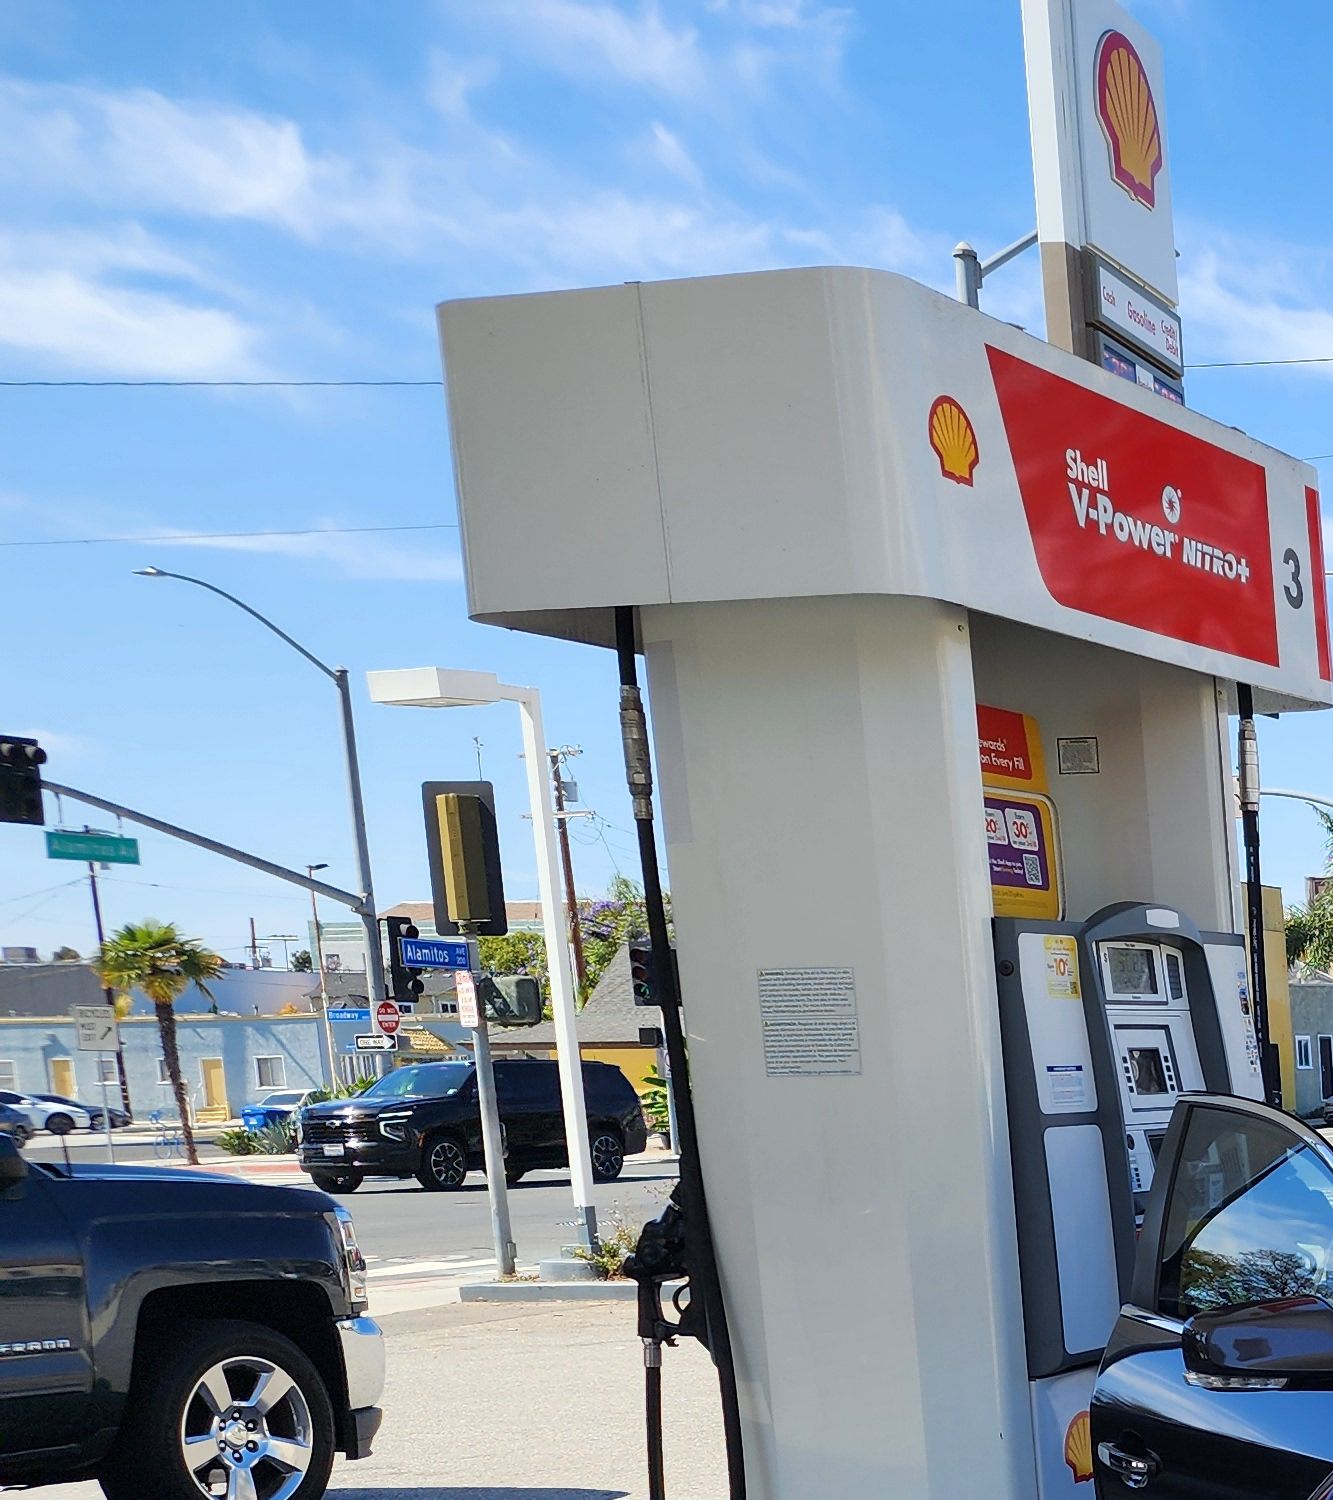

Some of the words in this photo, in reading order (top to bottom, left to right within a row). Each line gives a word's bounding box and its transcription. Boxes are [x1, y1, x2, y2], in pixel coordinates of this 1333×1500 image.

[1102, 286, 1116, 306] Cash
[1127, 300, 1156, 336] Gasoline
[1165, 337, 1179, 358] Debit
[1065, 448, 1109, 491] Shell
[1067, 482, 1178, 558] V-Power
[1282, 547, 1304, 610] 3
[991, 752, 1013, 772] Every
[1014, 756, 1025, 770] Fill
[407, 945, 449, 963] Alamitos
[456, 947, 465, 955] AVE
[328, 1011, 359, 1020] Broadway
